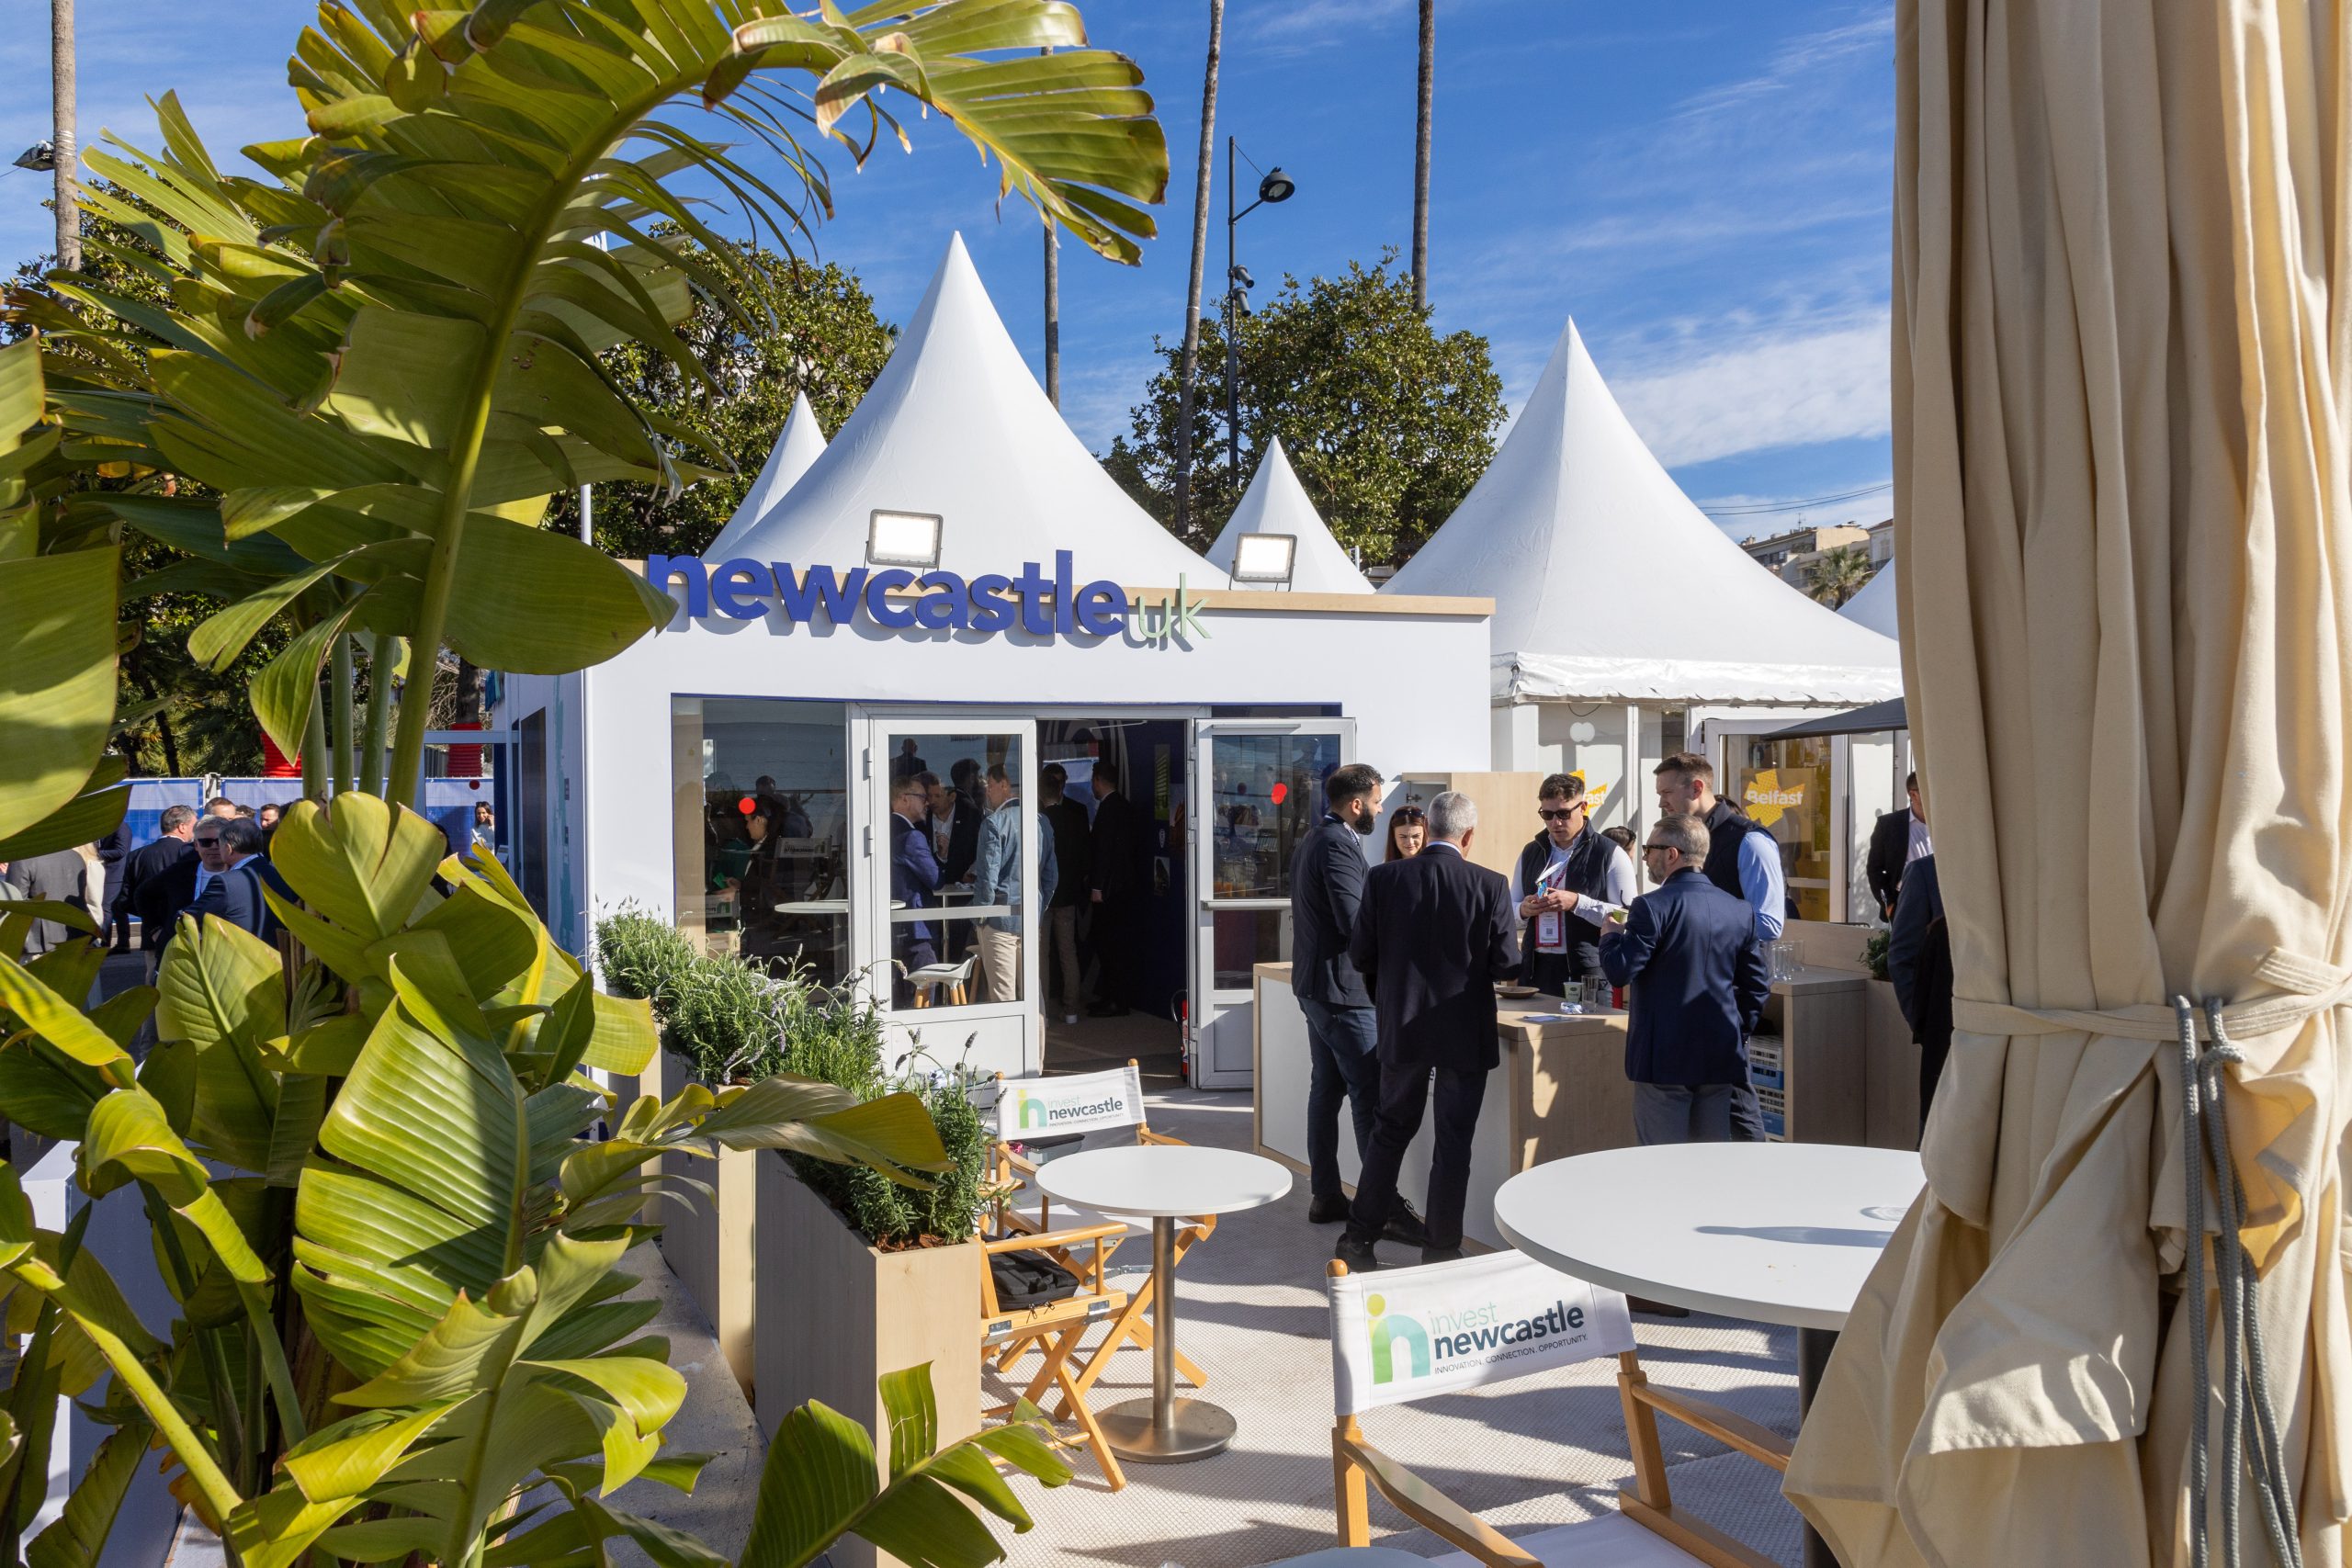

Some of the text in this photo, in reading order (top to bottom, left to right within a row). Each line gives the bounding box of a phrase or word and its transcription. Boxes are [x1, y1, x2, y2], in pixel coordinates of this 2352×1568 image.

[647, 549, 1214, 641] newcastle uk
[1584, 788, 1607, 807] fast
[1747, 790, 1804, 806] Belfast
[1047, 1095, 1081, 1108] invest
[1049, 1097, 1123, 1120] newcastle
[1428, 1301, 1499, 1336] invest
[1434, 1300, 1585, 1360] newcastle
[1434, 1333, 1589, 1374] INNOVATION. CONNECTION. OPPORTUNITY.
